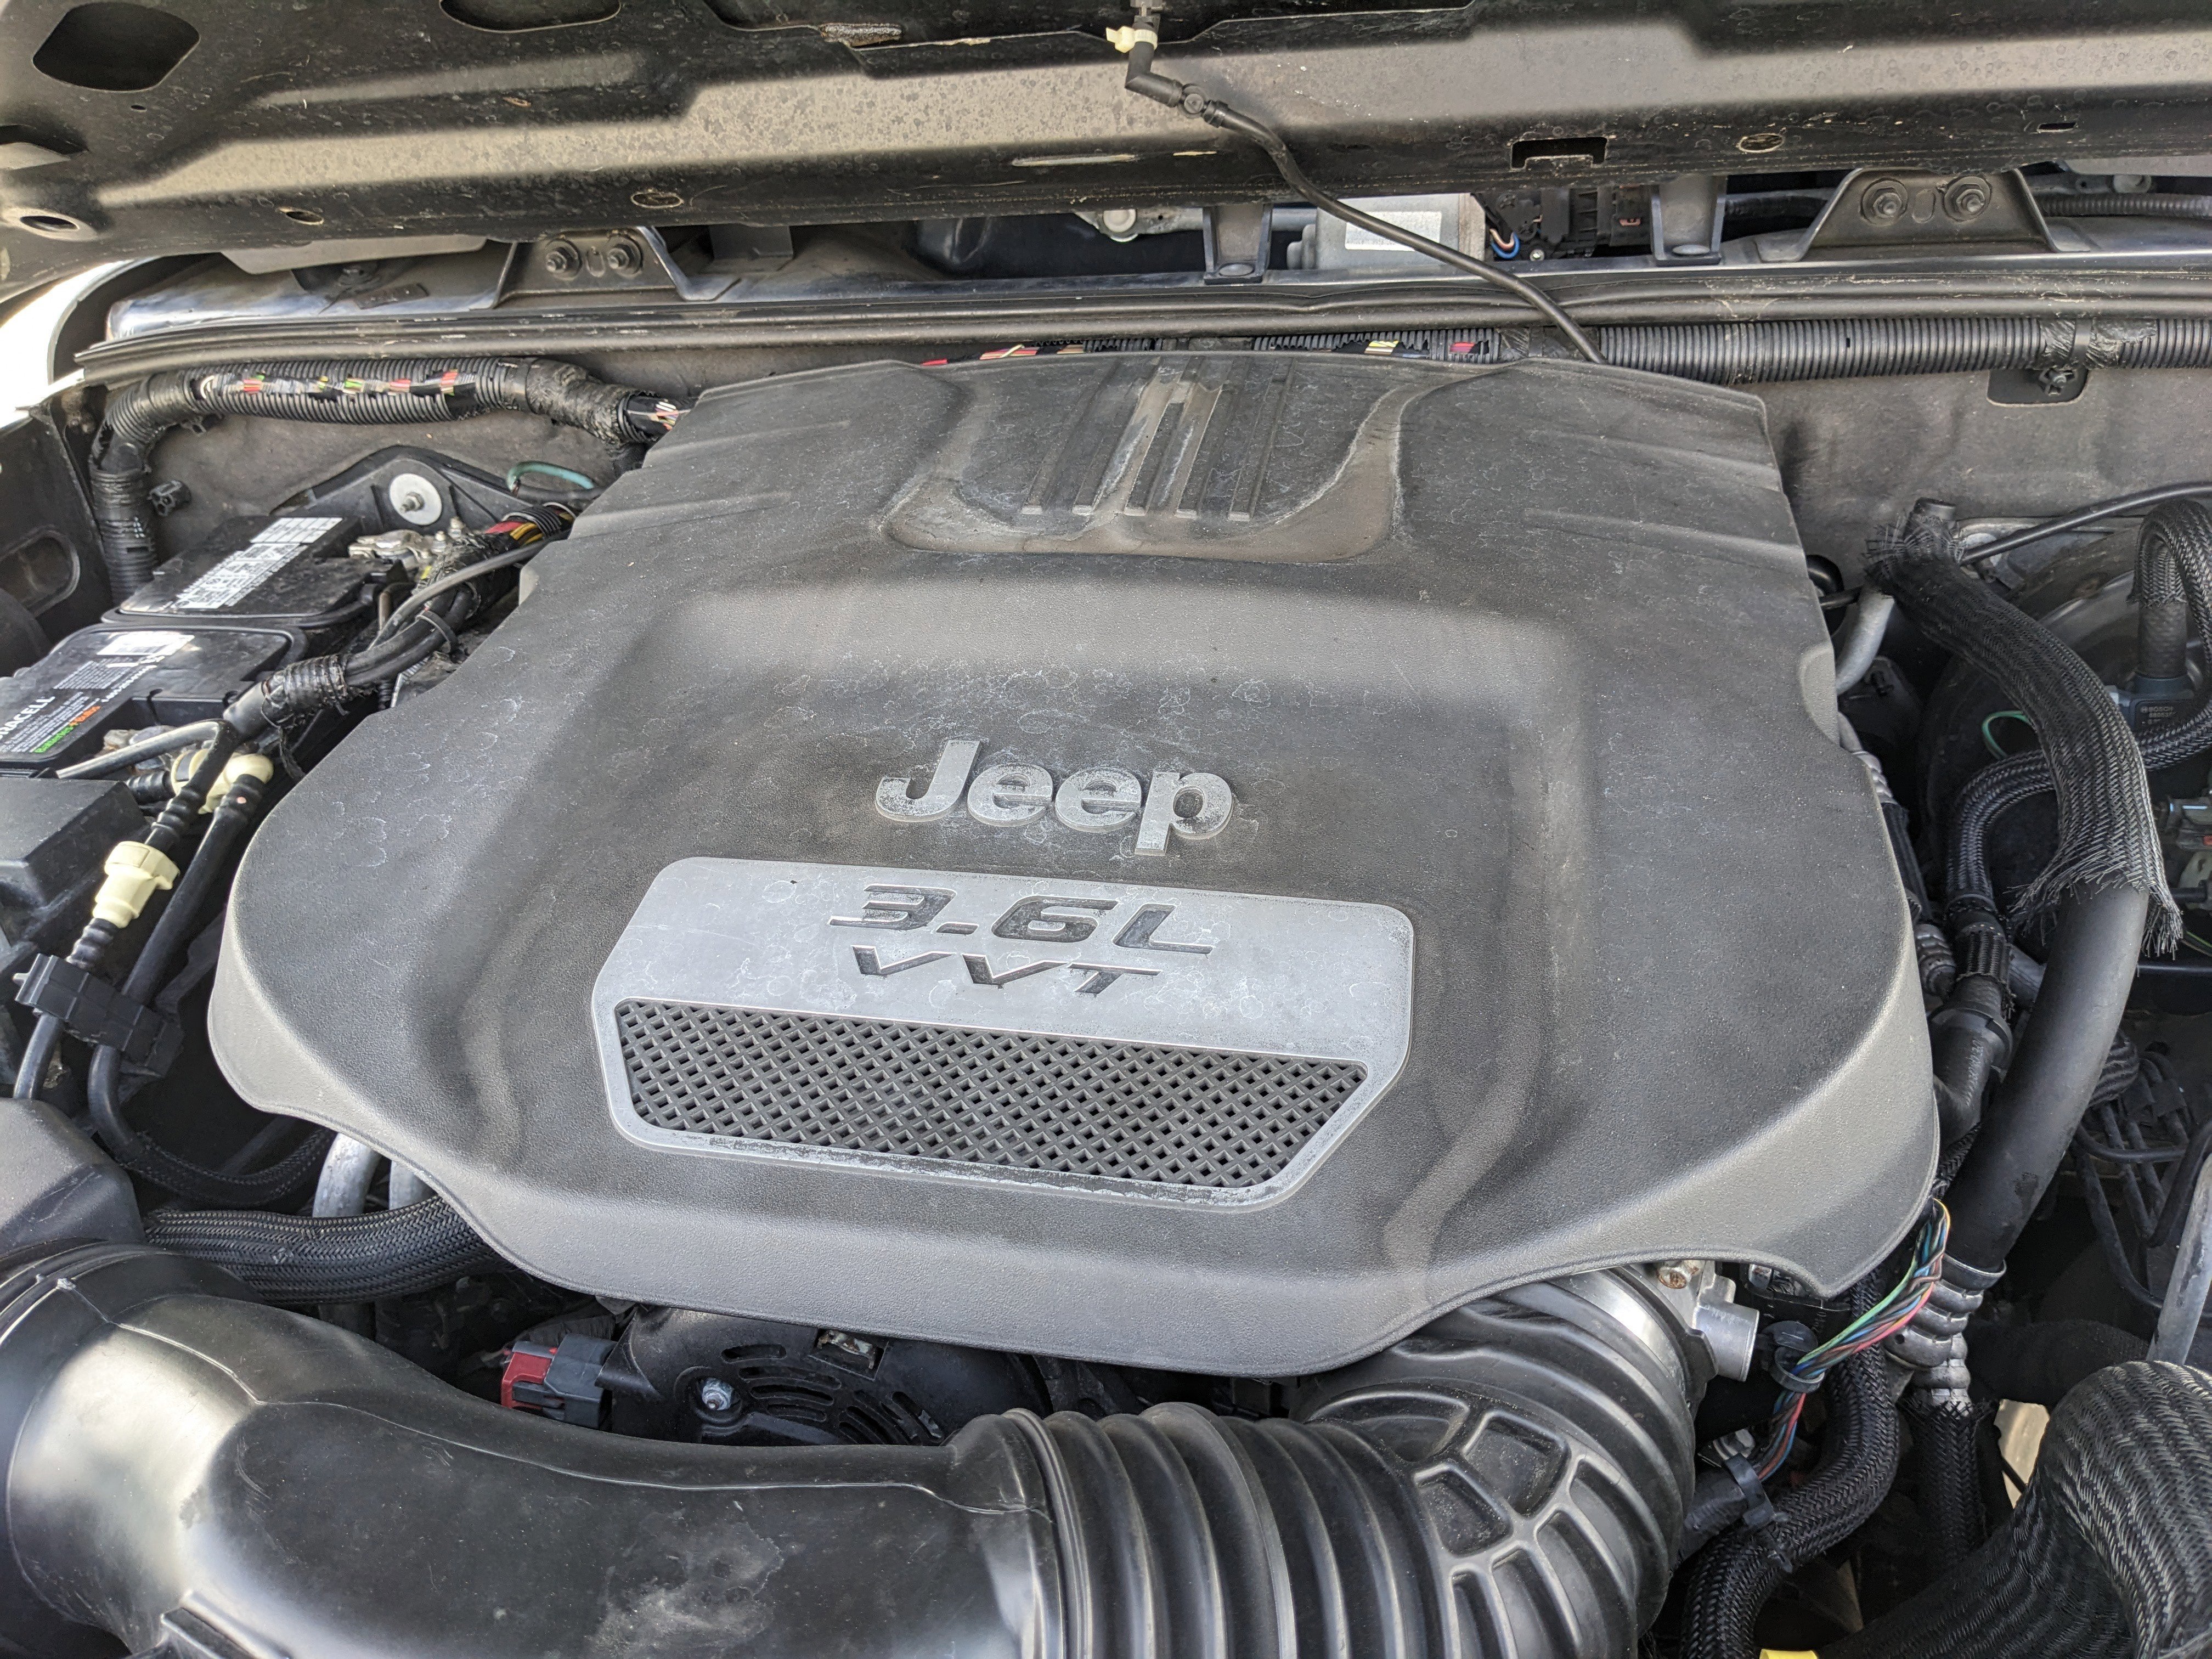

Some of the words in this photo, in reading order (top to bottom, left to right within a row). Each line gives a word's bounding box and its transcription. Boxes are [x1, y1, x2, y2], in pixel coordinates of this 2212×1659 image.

[876, 739, 1237, 856] Jeep
[828, 883, 1214, 955] 3.6L
[851, 945, 1163, 997] VVT
